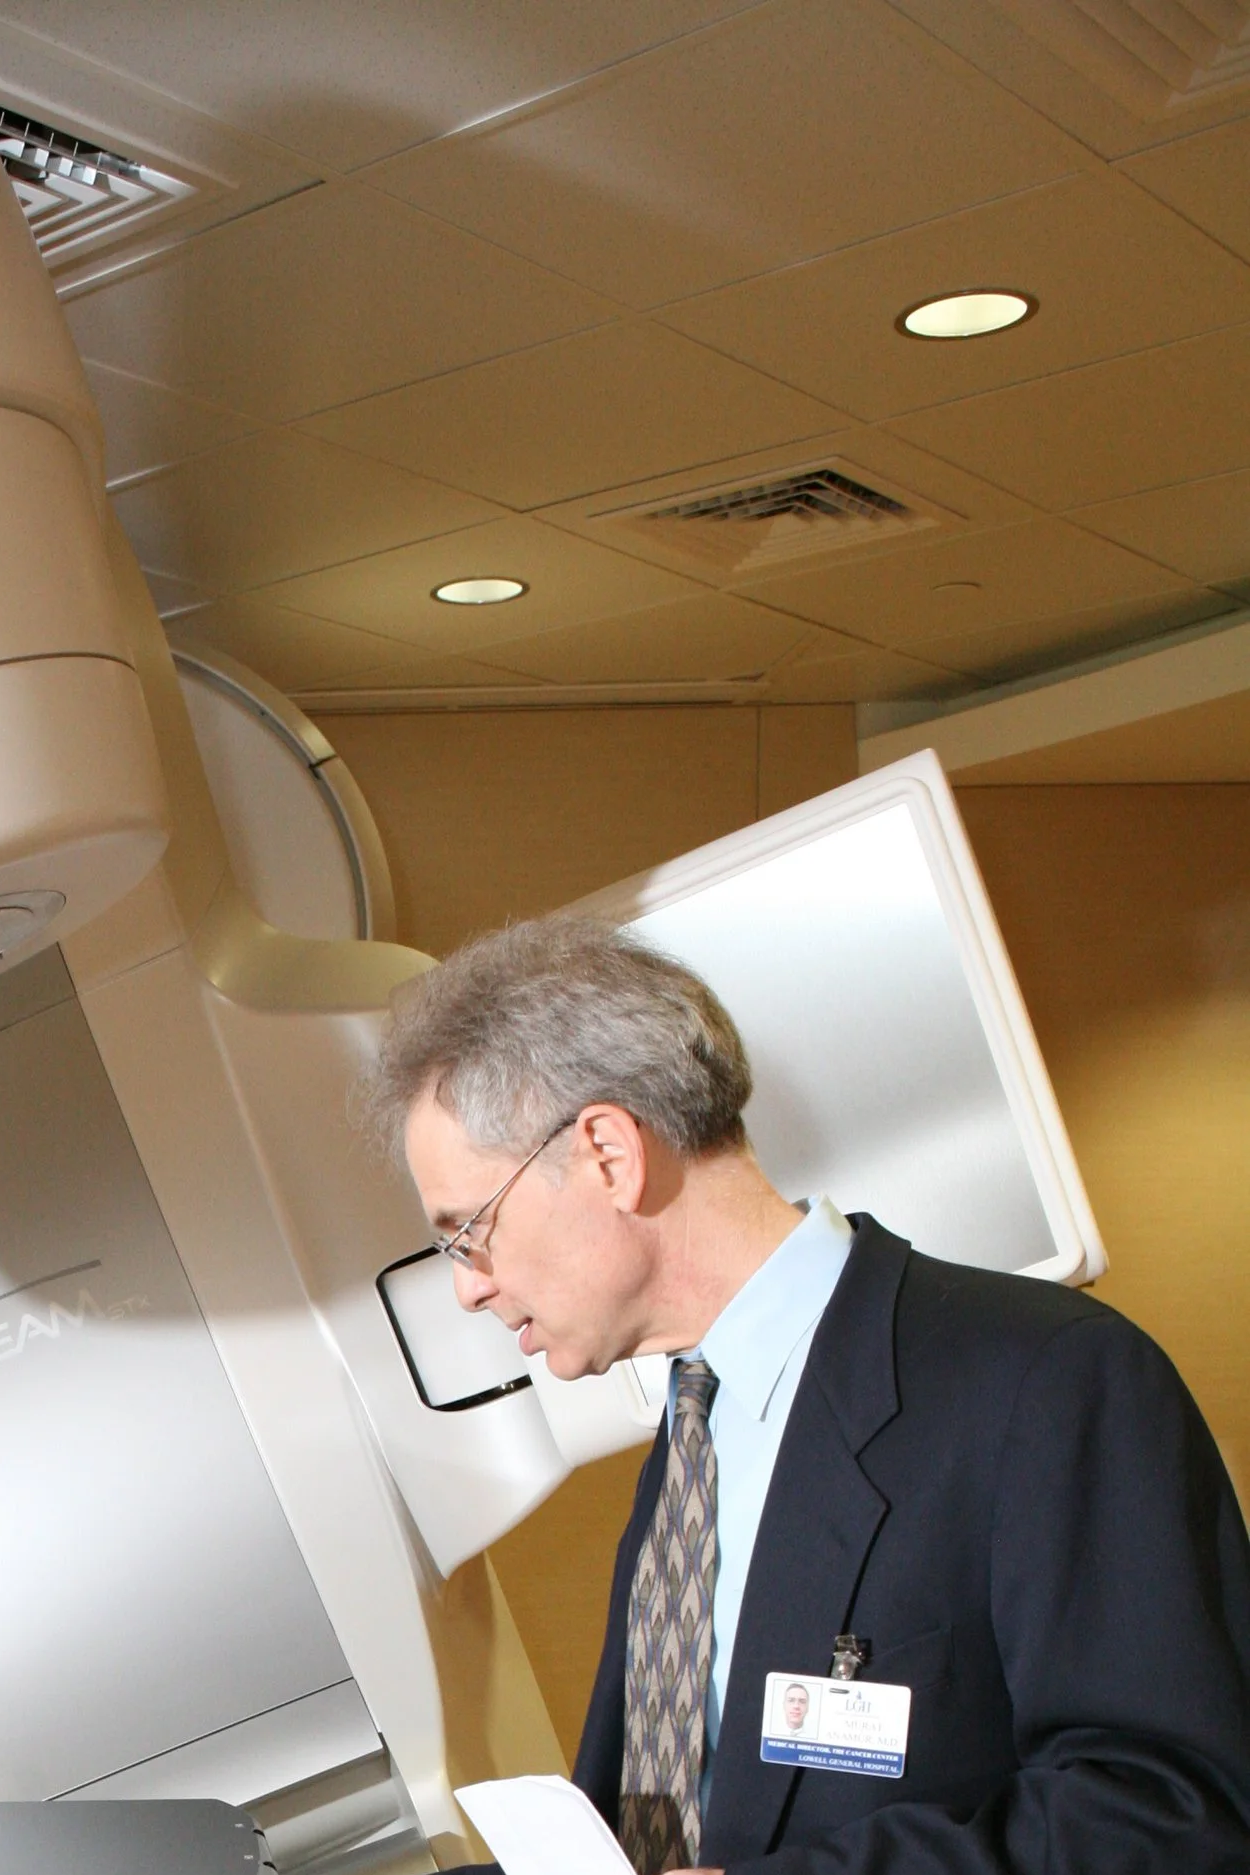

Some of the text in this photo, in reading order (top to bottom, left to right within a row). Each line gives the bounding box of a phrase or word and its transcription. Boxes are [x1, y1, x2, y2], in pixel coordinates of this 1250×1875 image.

[767, 1740, 796, 1749] MEDICAL
[798, 1754, 900, 1773] LOWELL GENERAL HOSPITAL
